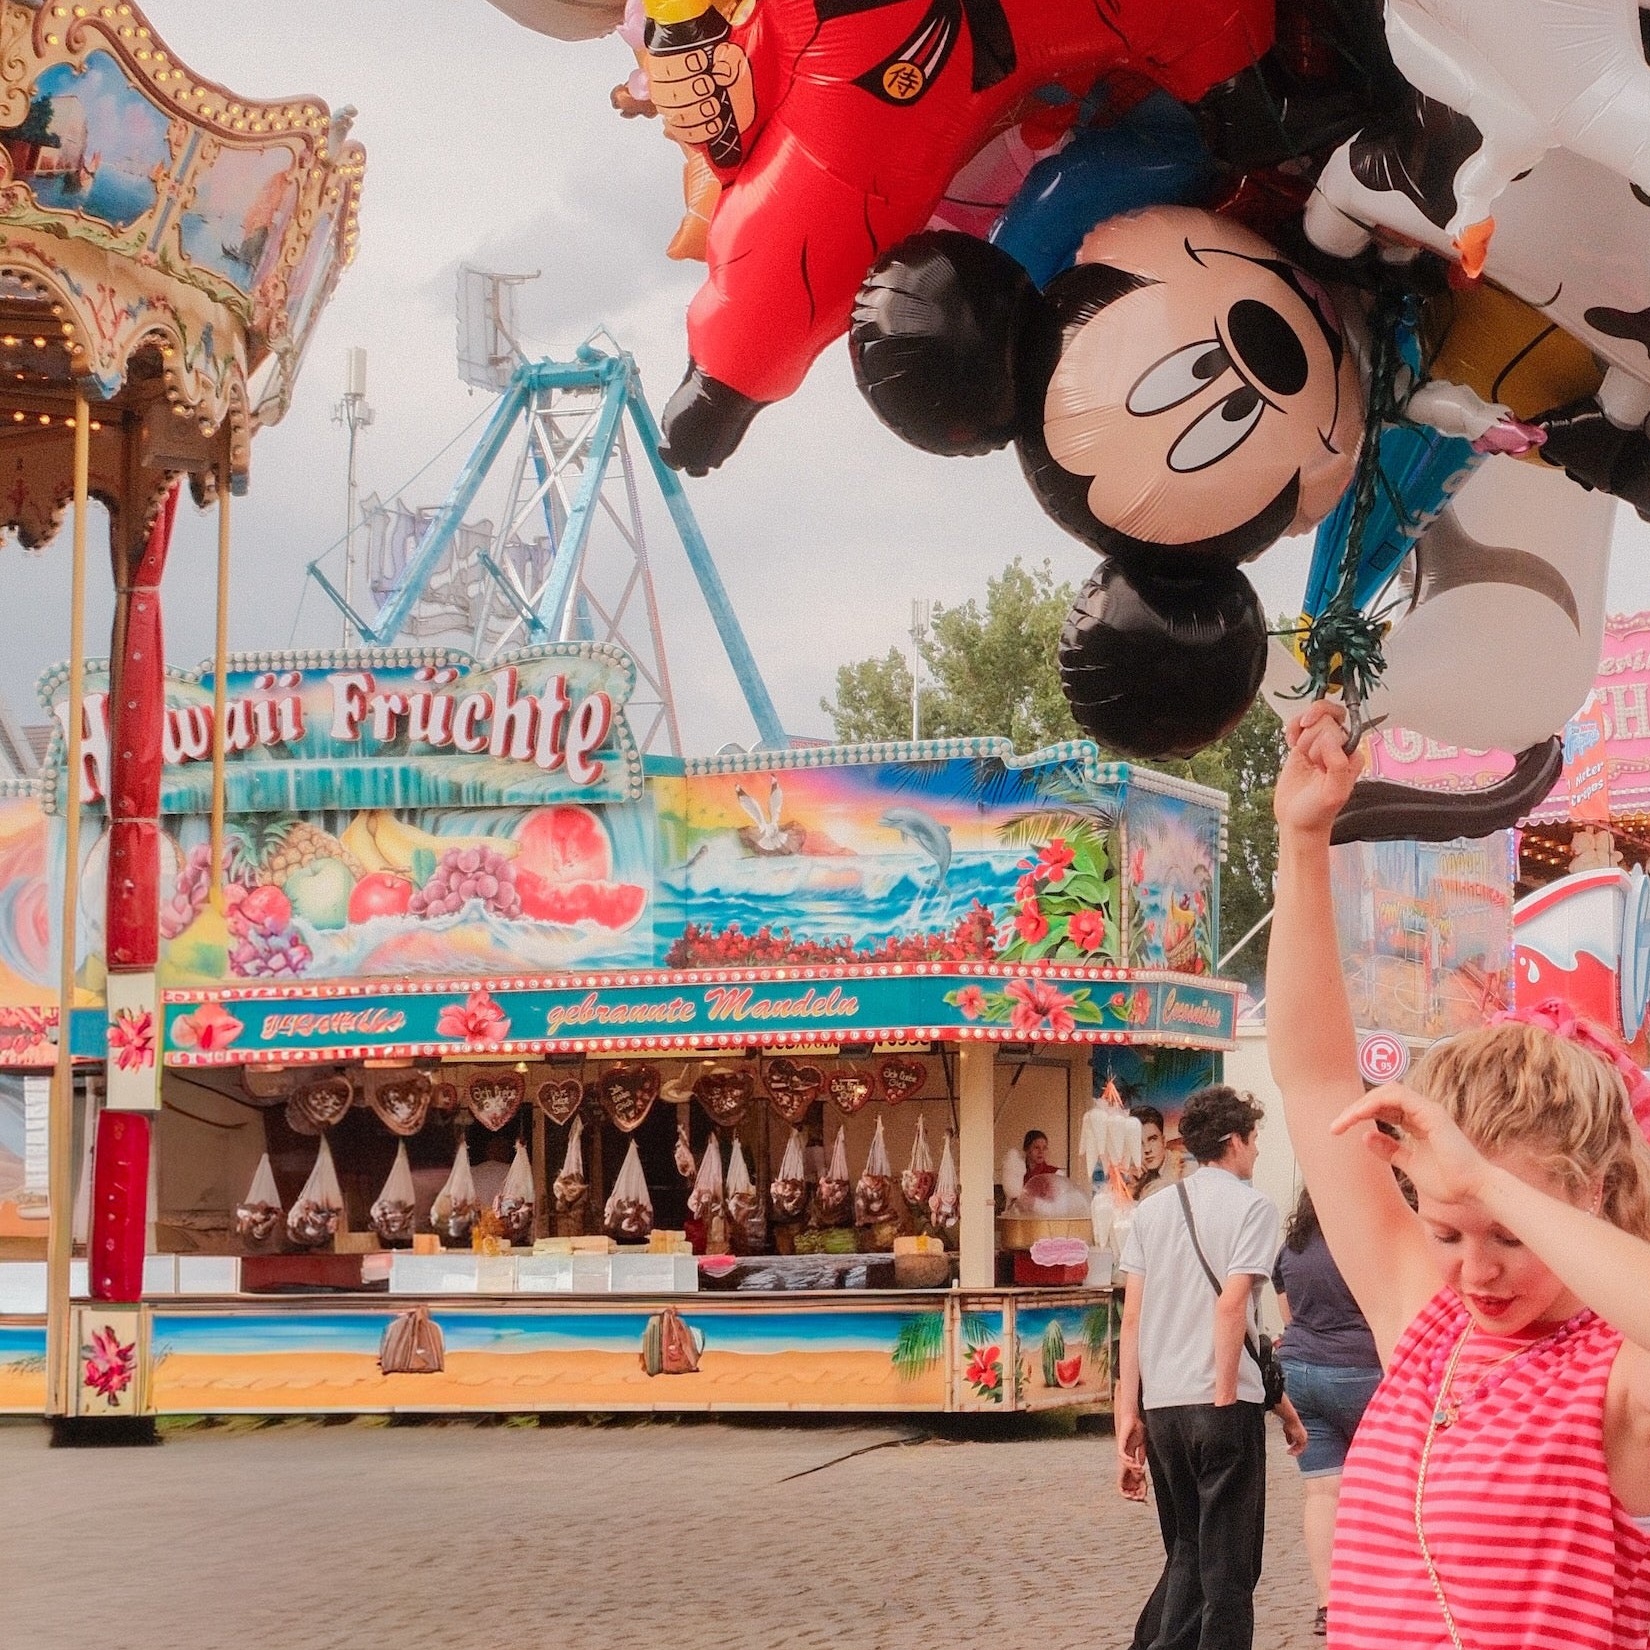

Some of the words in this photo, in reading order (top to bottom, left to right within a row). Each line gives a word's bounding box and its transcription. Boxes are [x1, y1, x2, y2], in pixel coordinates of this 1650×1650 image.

[887, 66, 919, 98] 侍
[54, 671, 307, 804] Hwaii
[327, 665, 612, 785] Früchte
[547, 991, 696, 1035] gebrannte
[704, 986, 859, 1021] Mandeln
[1380, 1060, 1393, 1072] 95
